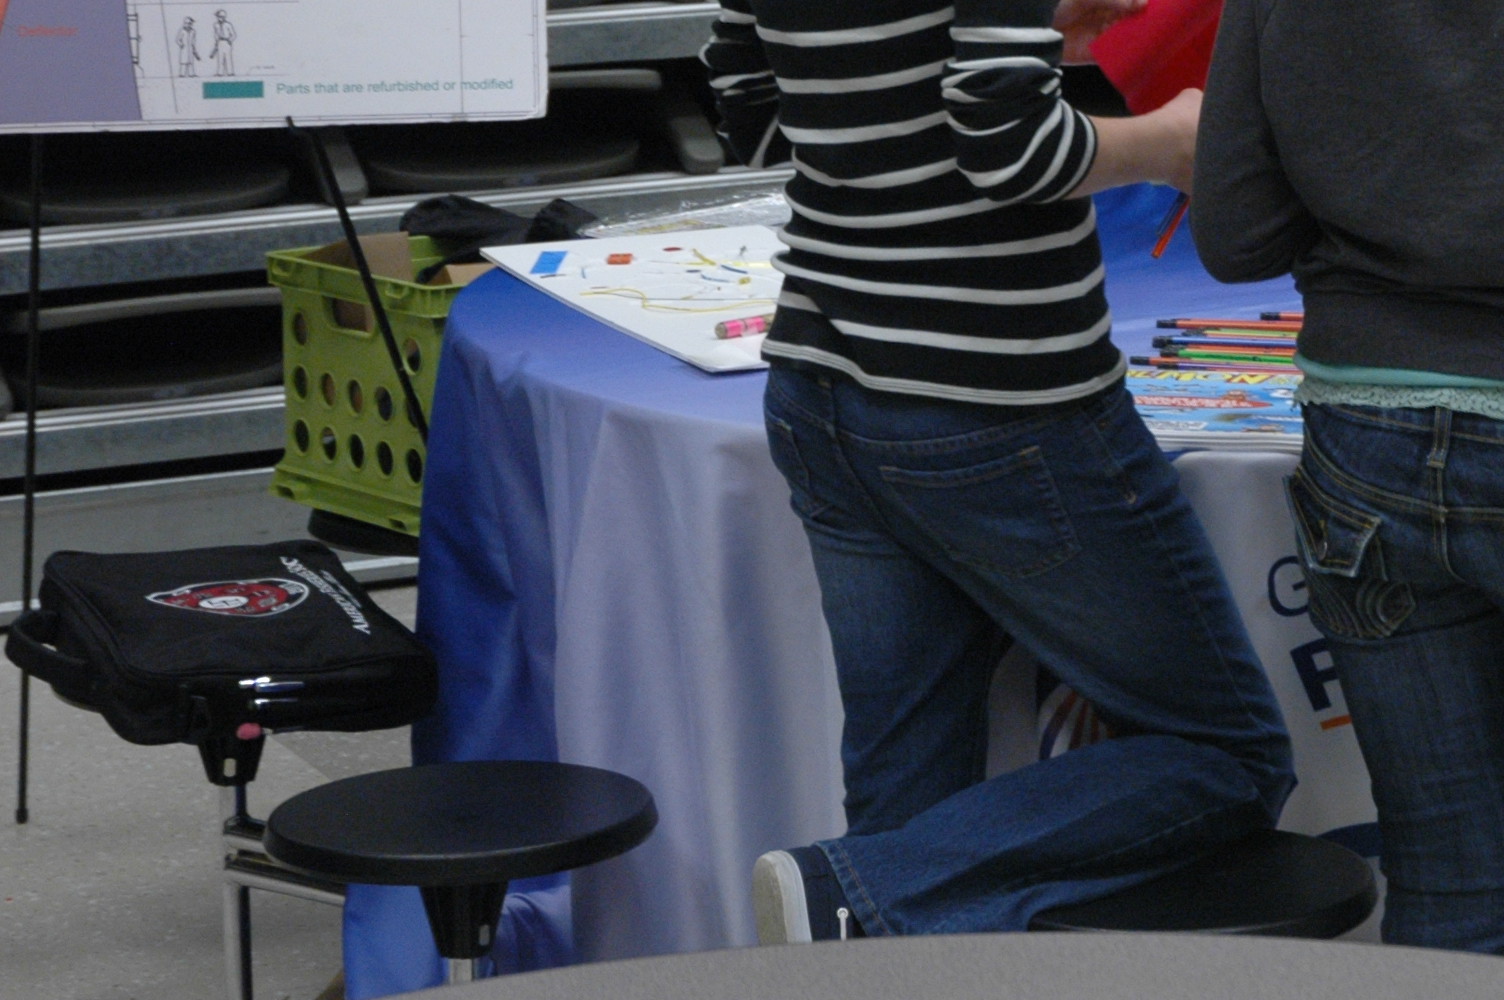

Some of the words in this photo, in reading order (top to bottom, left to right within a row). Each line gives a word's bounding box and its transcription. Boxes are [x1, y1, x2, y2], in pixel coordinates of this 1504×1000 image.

[276, 82, 310, 94] Parts
[314, 81, 338, 93] that
[342, 82, 363, 93] are
[367, 79, 440, 92] refurbished
[443, 82, 455, 91] or
[460, 78, 514, 91] modified
